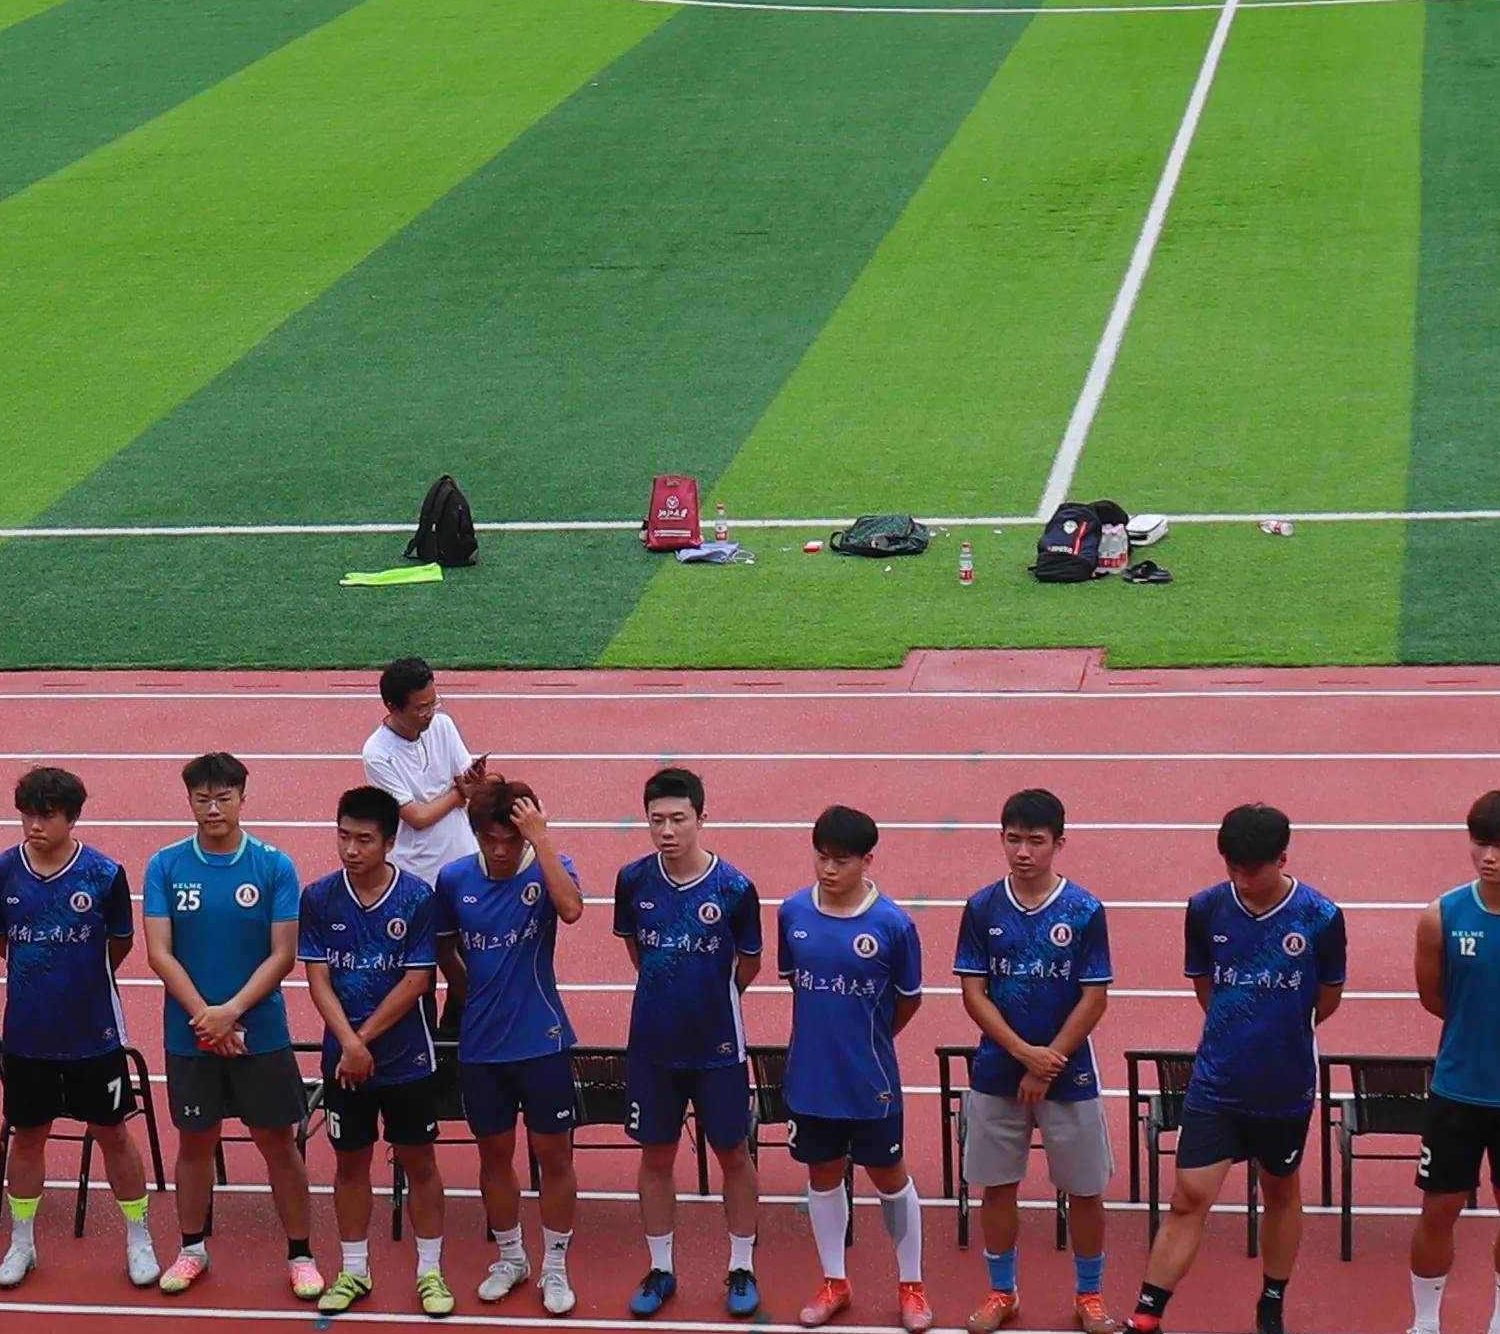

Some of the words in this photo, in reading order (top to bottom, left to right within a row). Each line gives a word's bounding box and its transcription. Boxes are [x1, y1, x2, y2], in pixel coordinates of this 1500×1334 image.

[176, 890, 201, 911] 25
[1460, 942, 1476, 956] 12
[107, 1075, 122, 1111] 7
